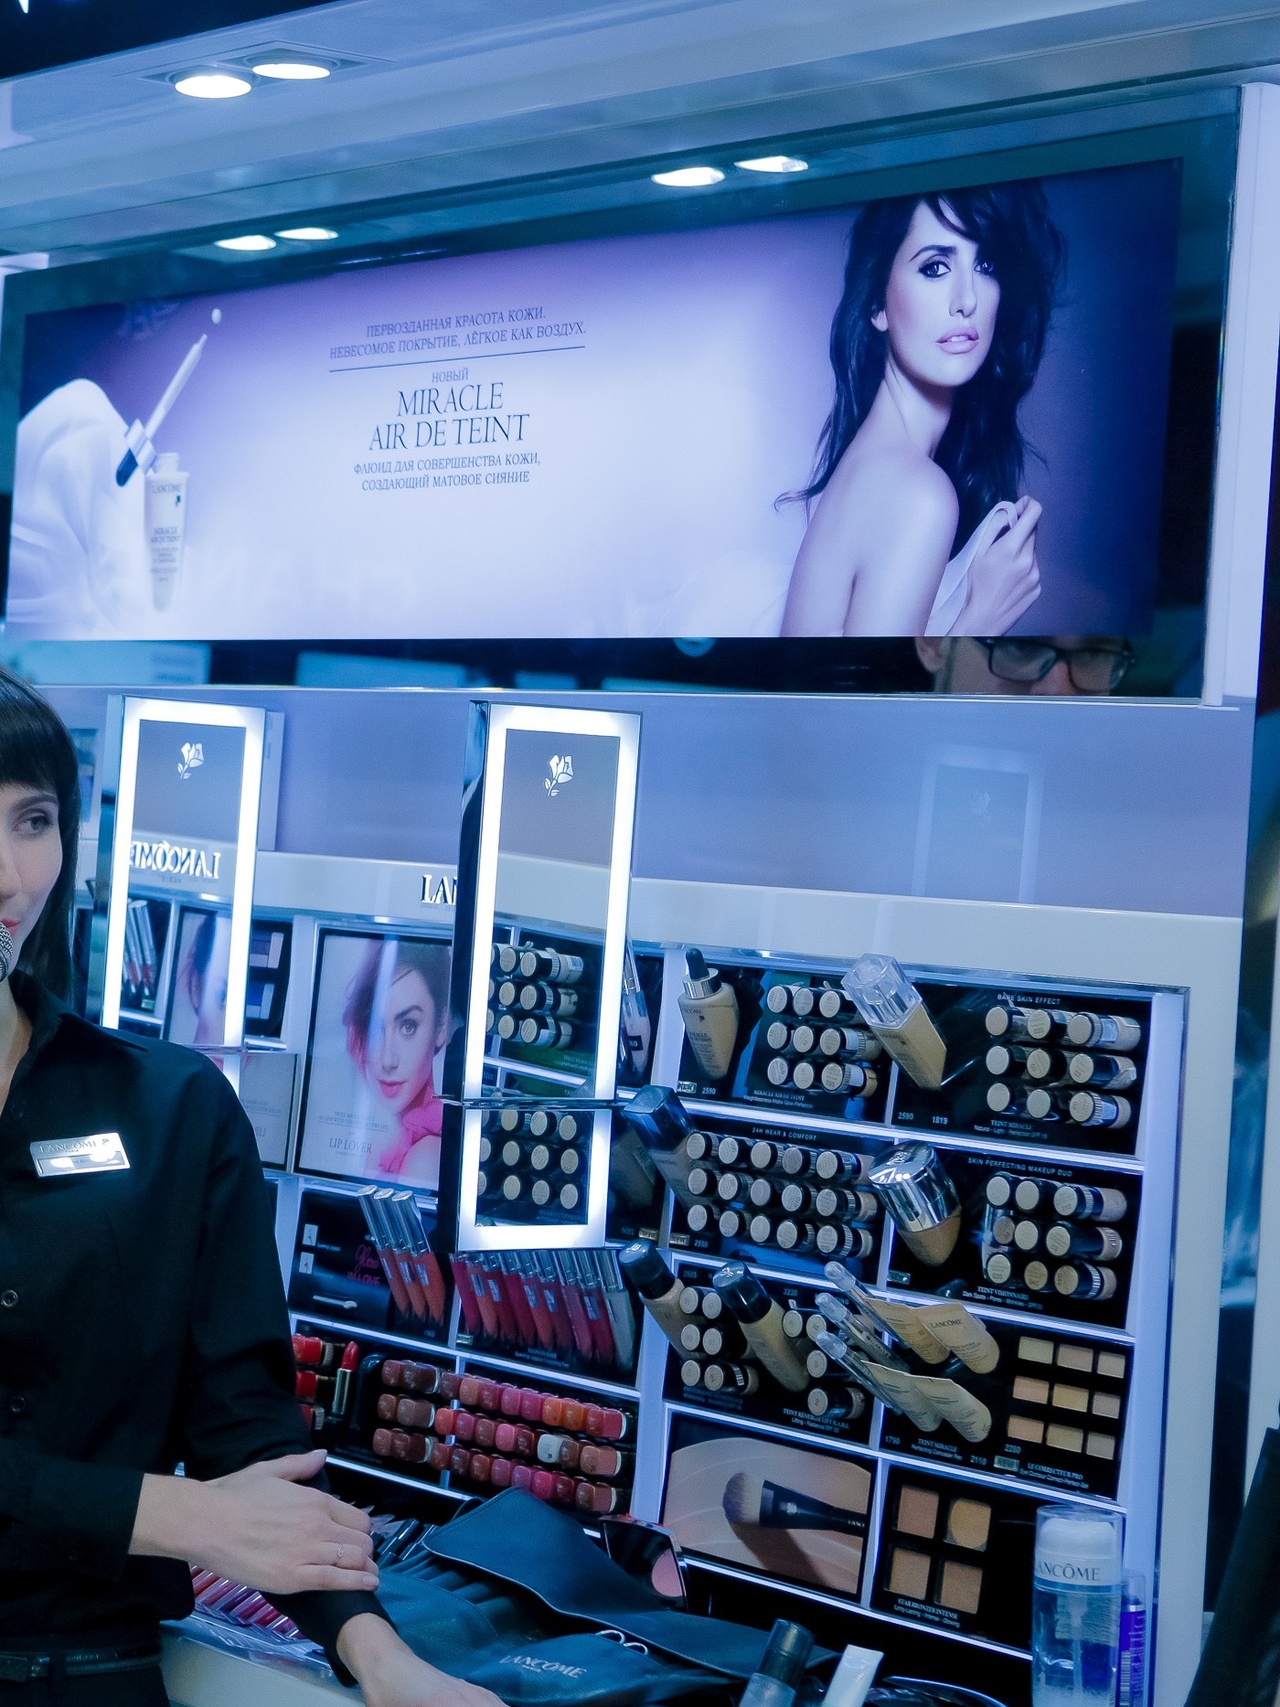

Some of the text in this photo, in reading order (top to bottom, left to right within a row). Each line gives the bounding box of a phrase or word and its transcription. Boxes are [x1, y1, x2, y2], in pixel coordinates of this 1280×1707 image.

[366, 317, 452, 338] ПЕРВОЗДАННАЯ
[455, 312, 505, 328] КРАСОТА
[329, 321, 586, 360] НЕВЕСОМОЕ ПОКРЫТИЕ, ЛЁГКОЕ КАК ВОЗДУХ.
[431, 366, 469, 383] НОВЫЙ
[397, 382, 504, 417] MIRACLE
[368, 414, 531, 452] AIR DE TEINT
[353, 452, 541, 475] ФЛЮИД ДЛЯ СОВЕРШЕНСТВА КОЖИ,
[361, 470, 530, 492] СОЗДАЮЩИЙ МАТОВОЕ СИЯНИЕ
[1017, 995, 1033, 1003] SKIN
[1035, 996, 1061, 1005] EFFECT
[752, 1126, 764, 1134] 24H
[765, 1128, 782, 1137] WEAR
[788, 1131, 818, 1141] COMFORT
[329, 1137, 343, 1149] LIP
[344, 1140, 372, 1154] LOVER
[968, 1157, 1073, 1177] SKIN PERFECTING MAKEUP DUO
